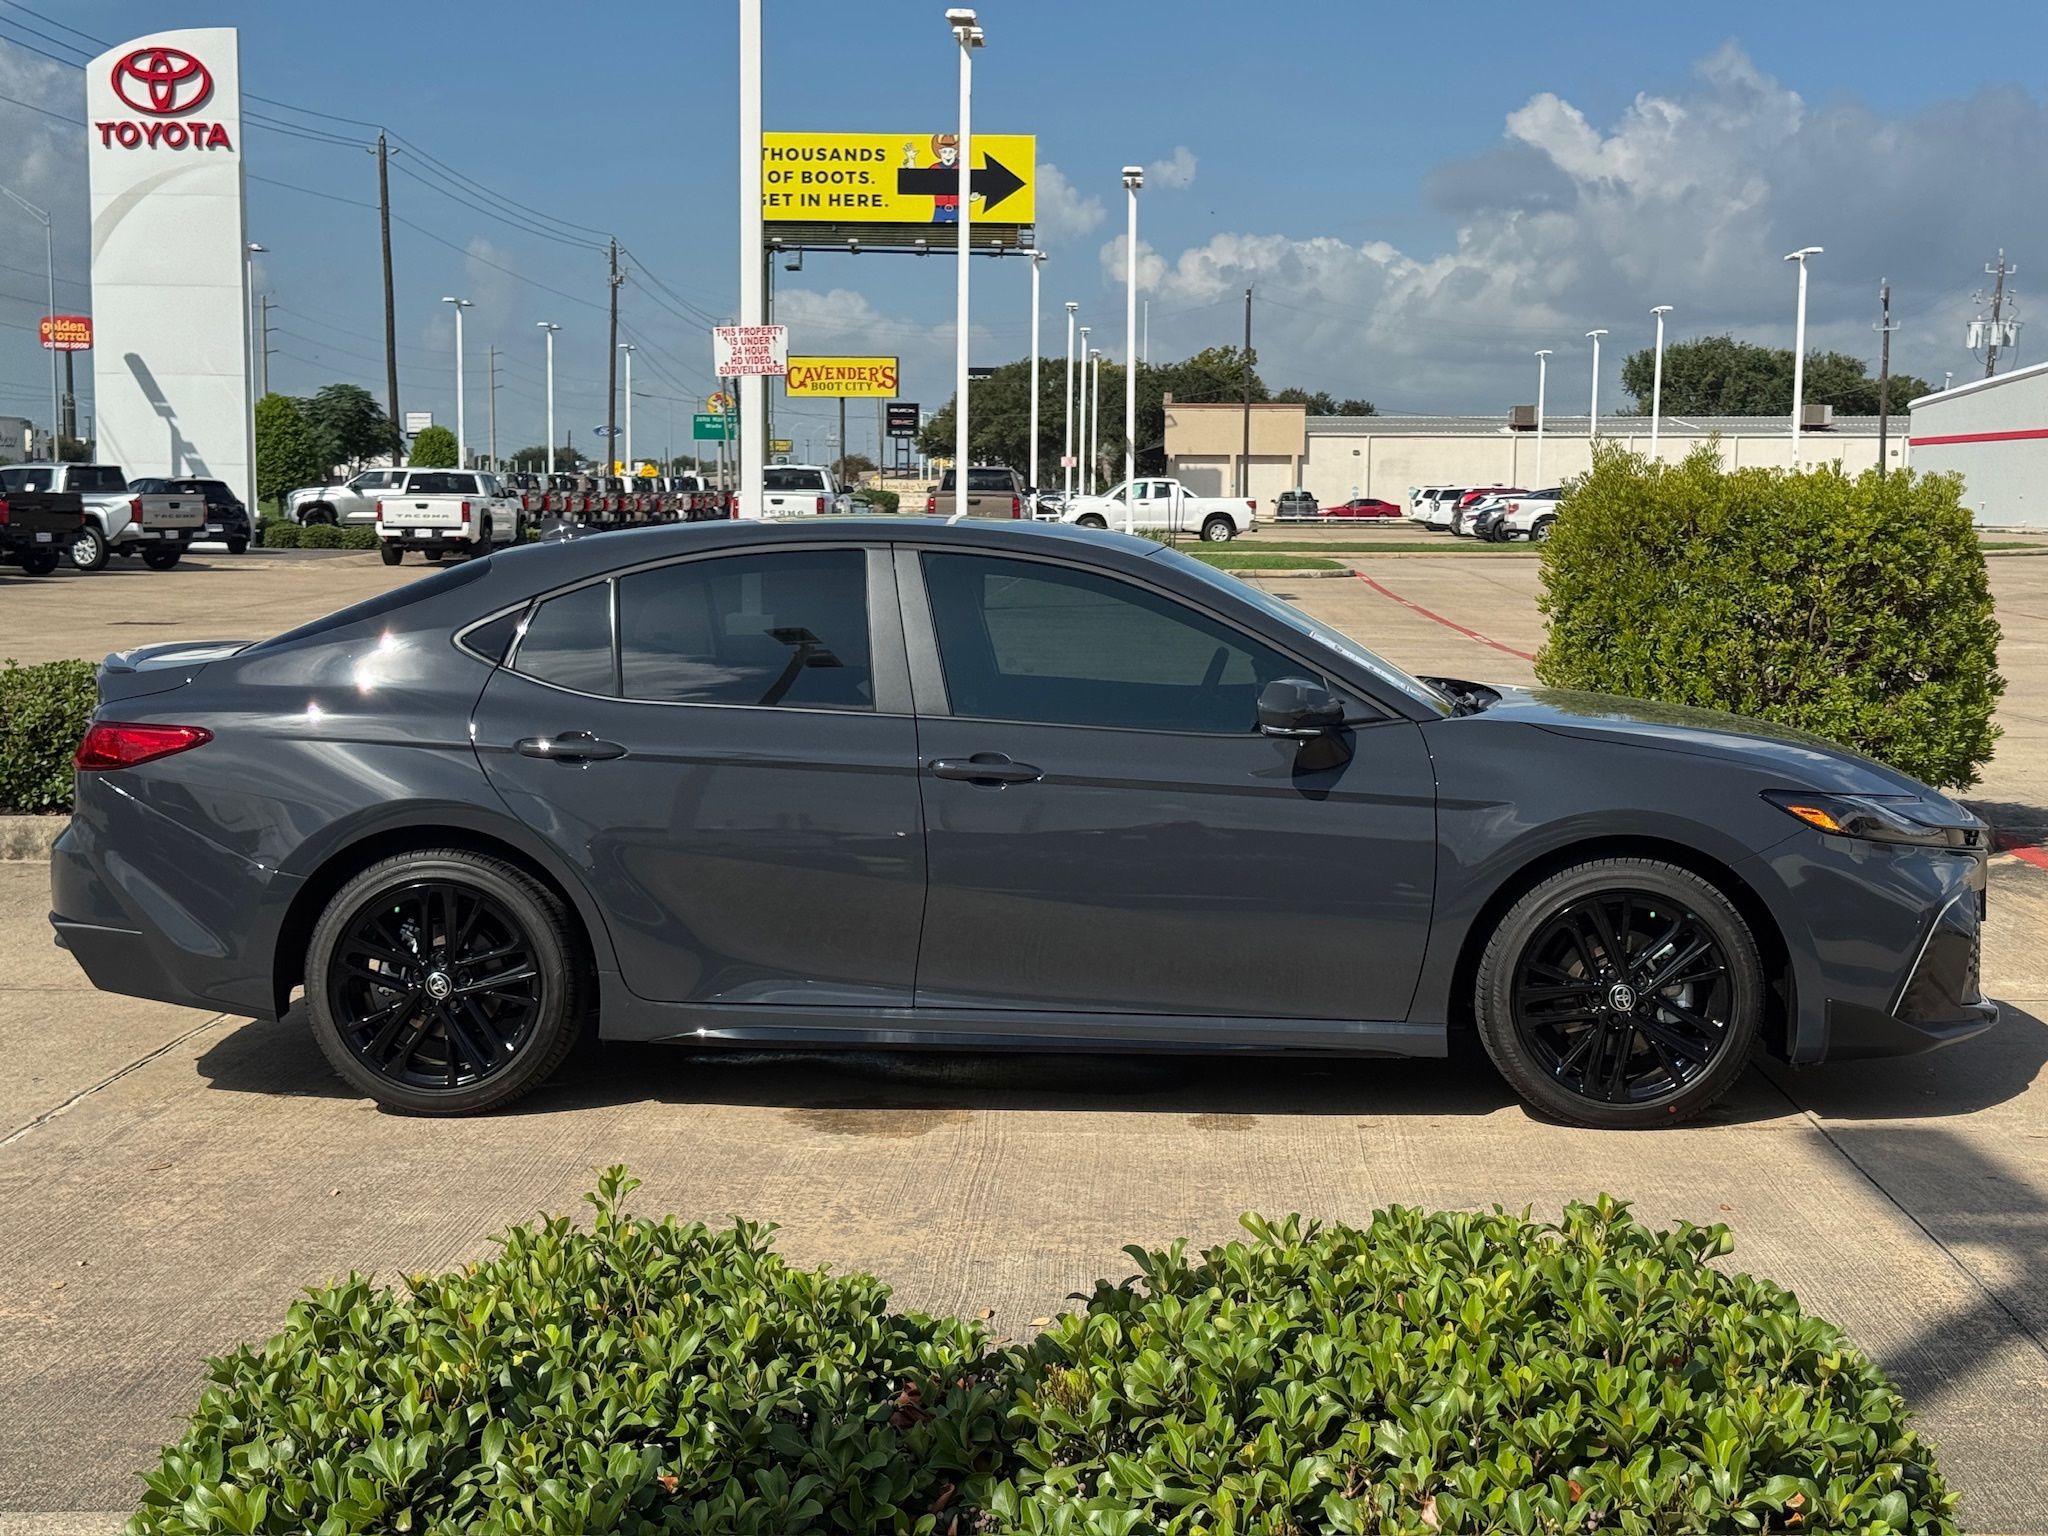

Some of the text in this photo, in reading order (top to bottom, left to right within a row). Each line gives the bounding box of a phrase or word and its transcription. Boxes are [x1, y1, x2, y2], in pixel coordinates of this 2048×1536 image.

[95, 121, 232, 149] TOYOTA
[762, 148, 886, 161] THOUSANDS
[768, 171, 876, 184] OF BOOTS.
[801, 194, 820, 206] IN
[829, 194, 889, 207] HERE.
[41, 320, 86, 334] golden
[716, 326, 784, 336] THIS PROPERTY
[730, 336, 771, 345] IS UNDER
[732, 346, 769, 355] 24 HOUR
[731, 355, 771, 365] HD VIDEO
[719, 365, 784, 374] SURVEILLANCE
[788, 365, 897, 389] CAVENDER'S
[811, 382, 872, 391] BOOT CITY
